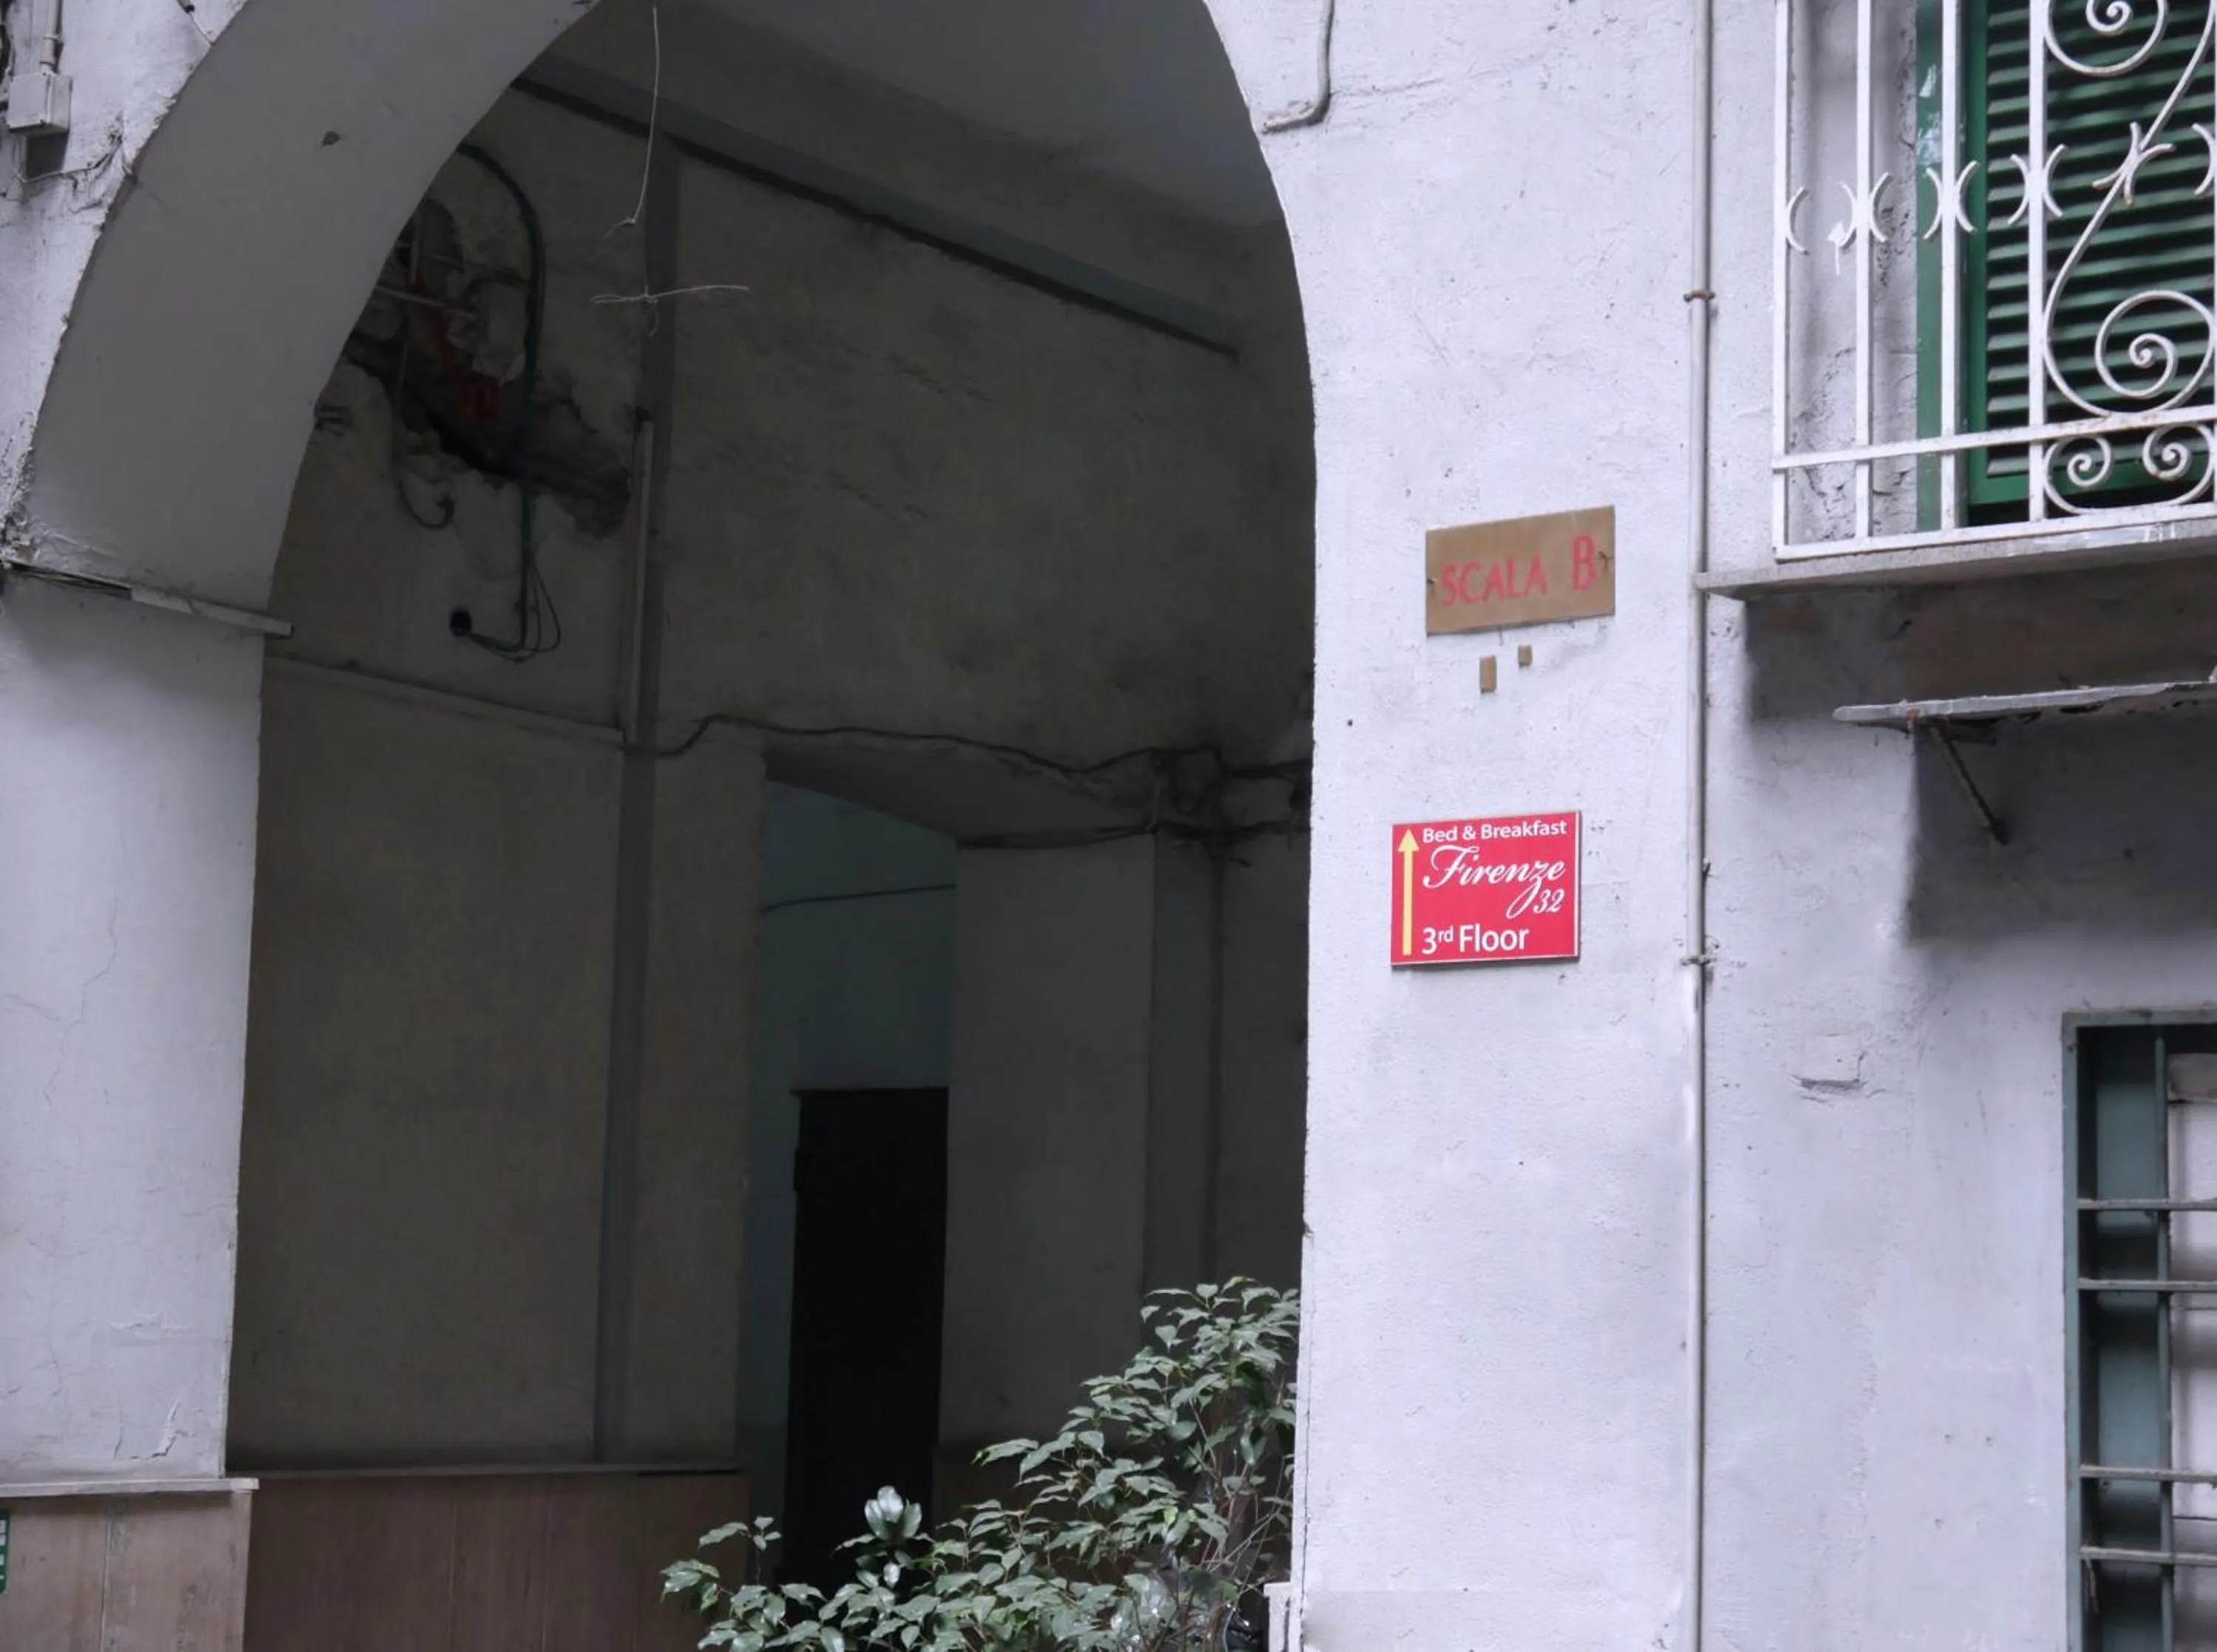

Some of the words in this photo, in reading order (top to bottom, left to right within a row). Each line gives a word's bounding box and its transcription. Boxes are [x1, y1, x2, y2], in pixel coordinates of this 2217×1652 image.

[1442, 552, 1547, 607] SCALA
[1572, 534, 1597, 592] B
[1423, 826, 1457, 843] Bed
[1462, 825, 1476, 840] &
[1481, 819, 1567, 839] Breakfast
[1423, 845, 1565, 918] Firenze
[1533, 889, 1564, 914] 32
[1422, 926, 1454, 955] 3rd
[1460, 924, 1530, 952] Floor
